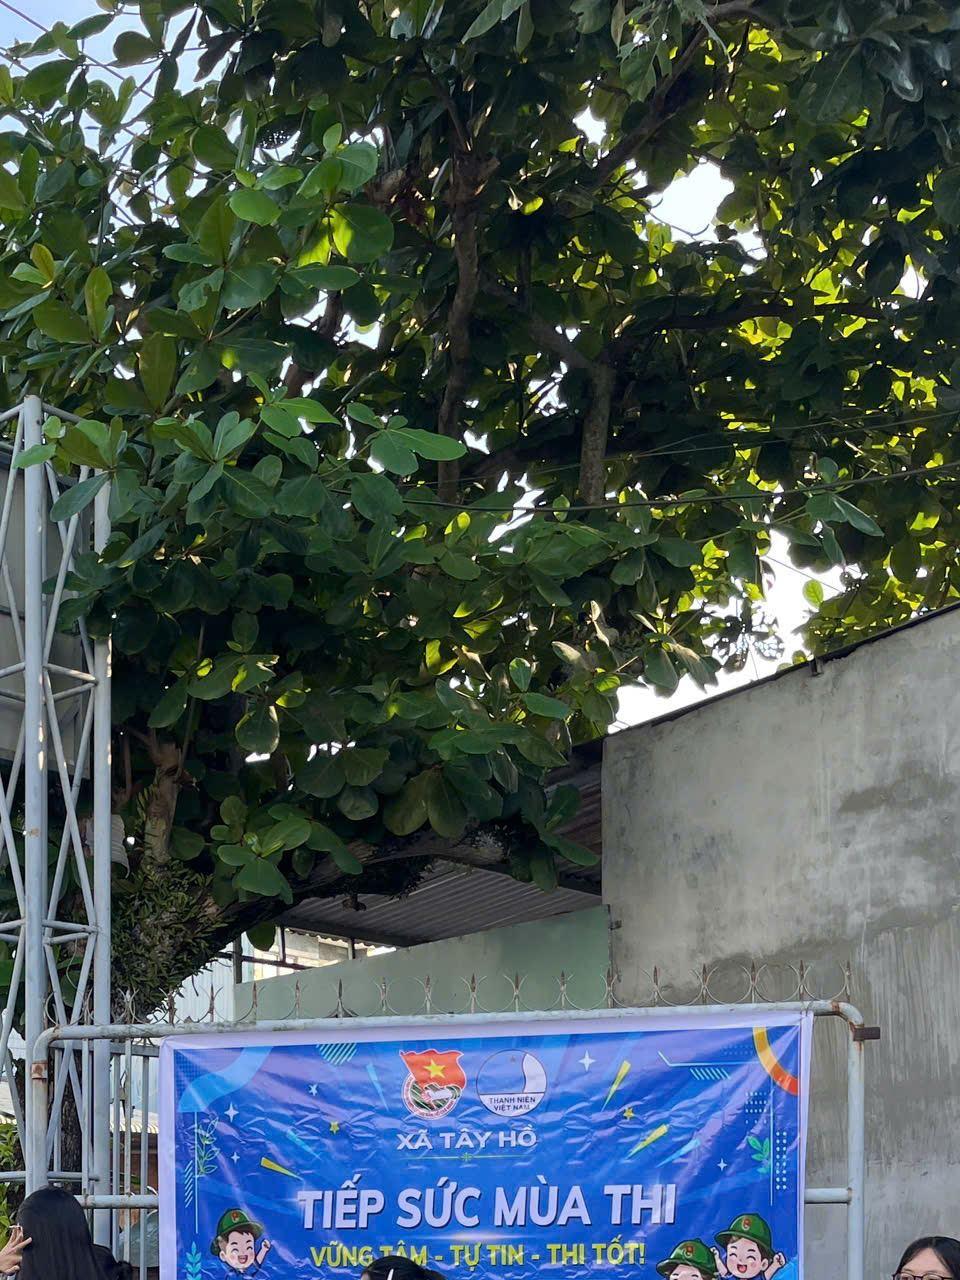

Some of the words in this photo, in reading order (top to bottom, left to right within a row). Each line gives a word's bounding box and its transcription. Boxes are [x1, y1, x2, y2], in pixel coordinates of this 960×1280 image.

[396, 1128, 433, 1150] XÃ
[440, 1127, 493, 1149] TÂY
[498, 1123, 537, 1148] HỒ
[296, 1173, 385, 1230] TIẾP
[396, 1175, 481, 1229] SỨC
[494, 1174, 592, 1227] MÙA
[604, 1183, 677, 1225] THI
[310, 1241, 374, 1268] VỮNG
[450, 1240, 482, 1271] TỰ
[488, 1245, 524, 1266] TIN
[546, 1243, 586, 1266] THI
[592, 1235, 646, 1265] TỐT!
